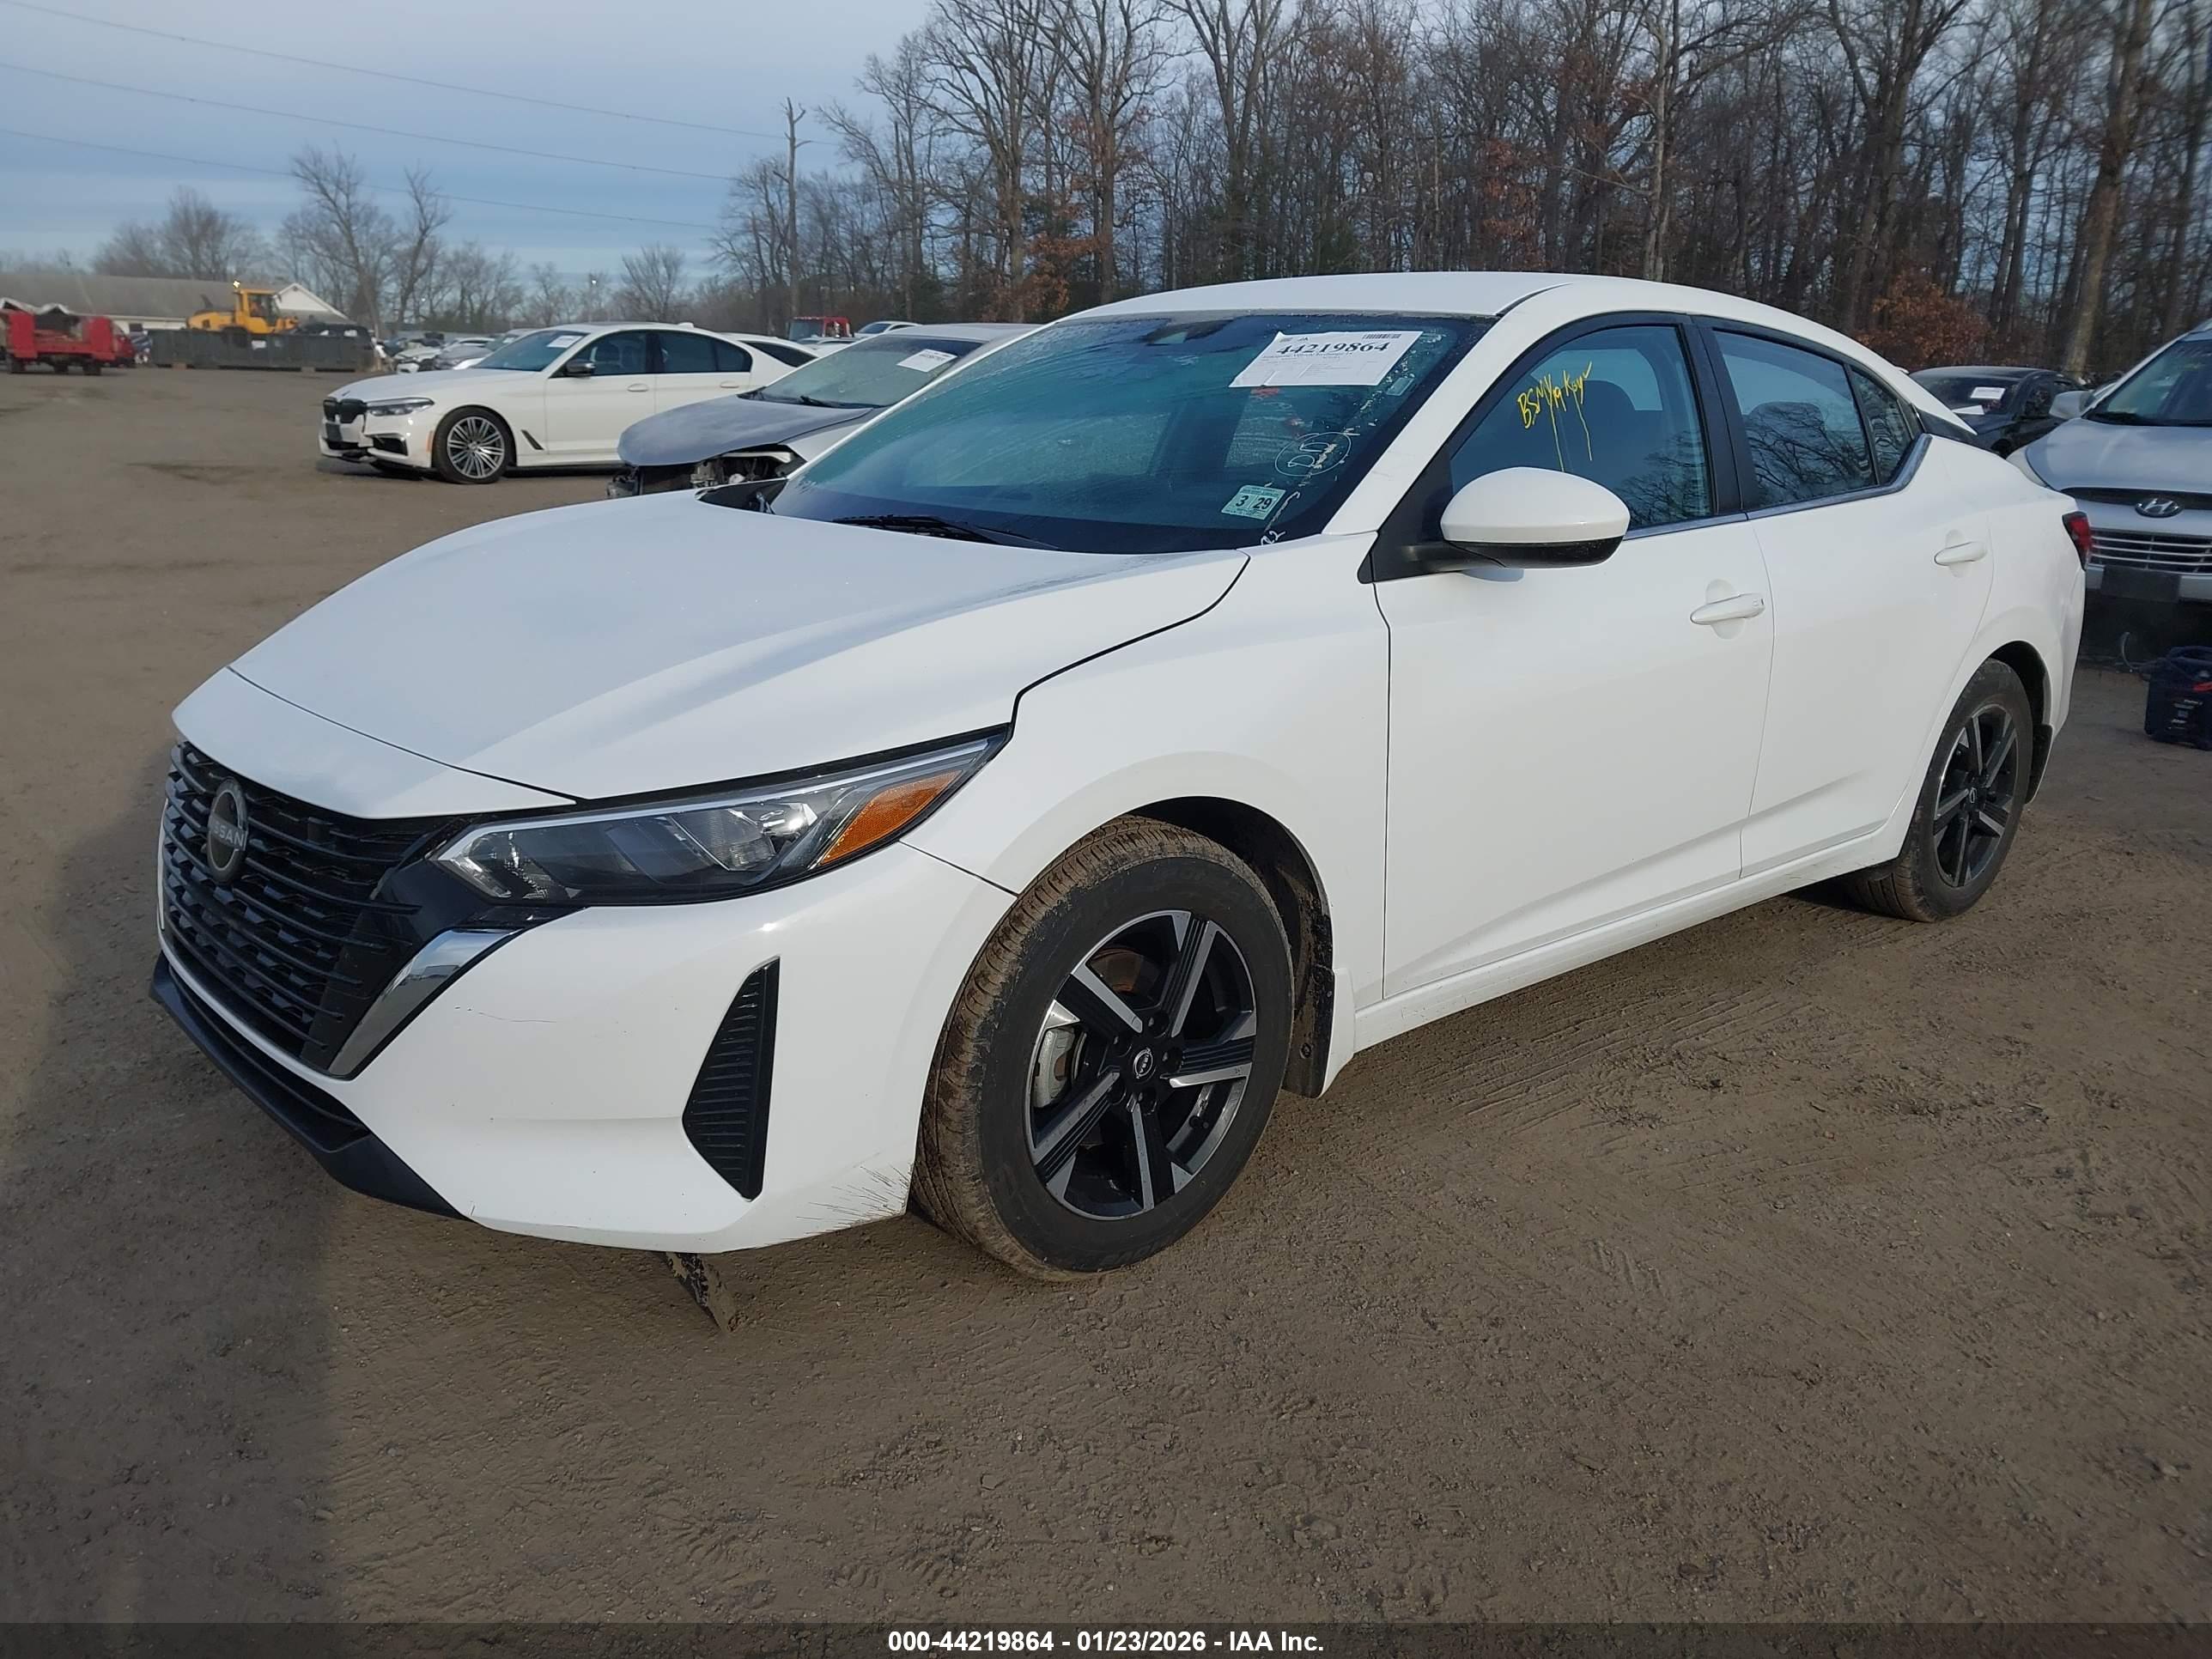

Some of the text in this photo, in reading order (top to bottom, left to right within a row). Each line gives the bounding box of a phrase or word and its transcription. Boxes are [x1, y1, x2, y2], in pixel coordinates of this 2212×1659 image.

[1276, 341, 1391, 356] 44219864
[1236, 495, 1273, 509] 3 29
